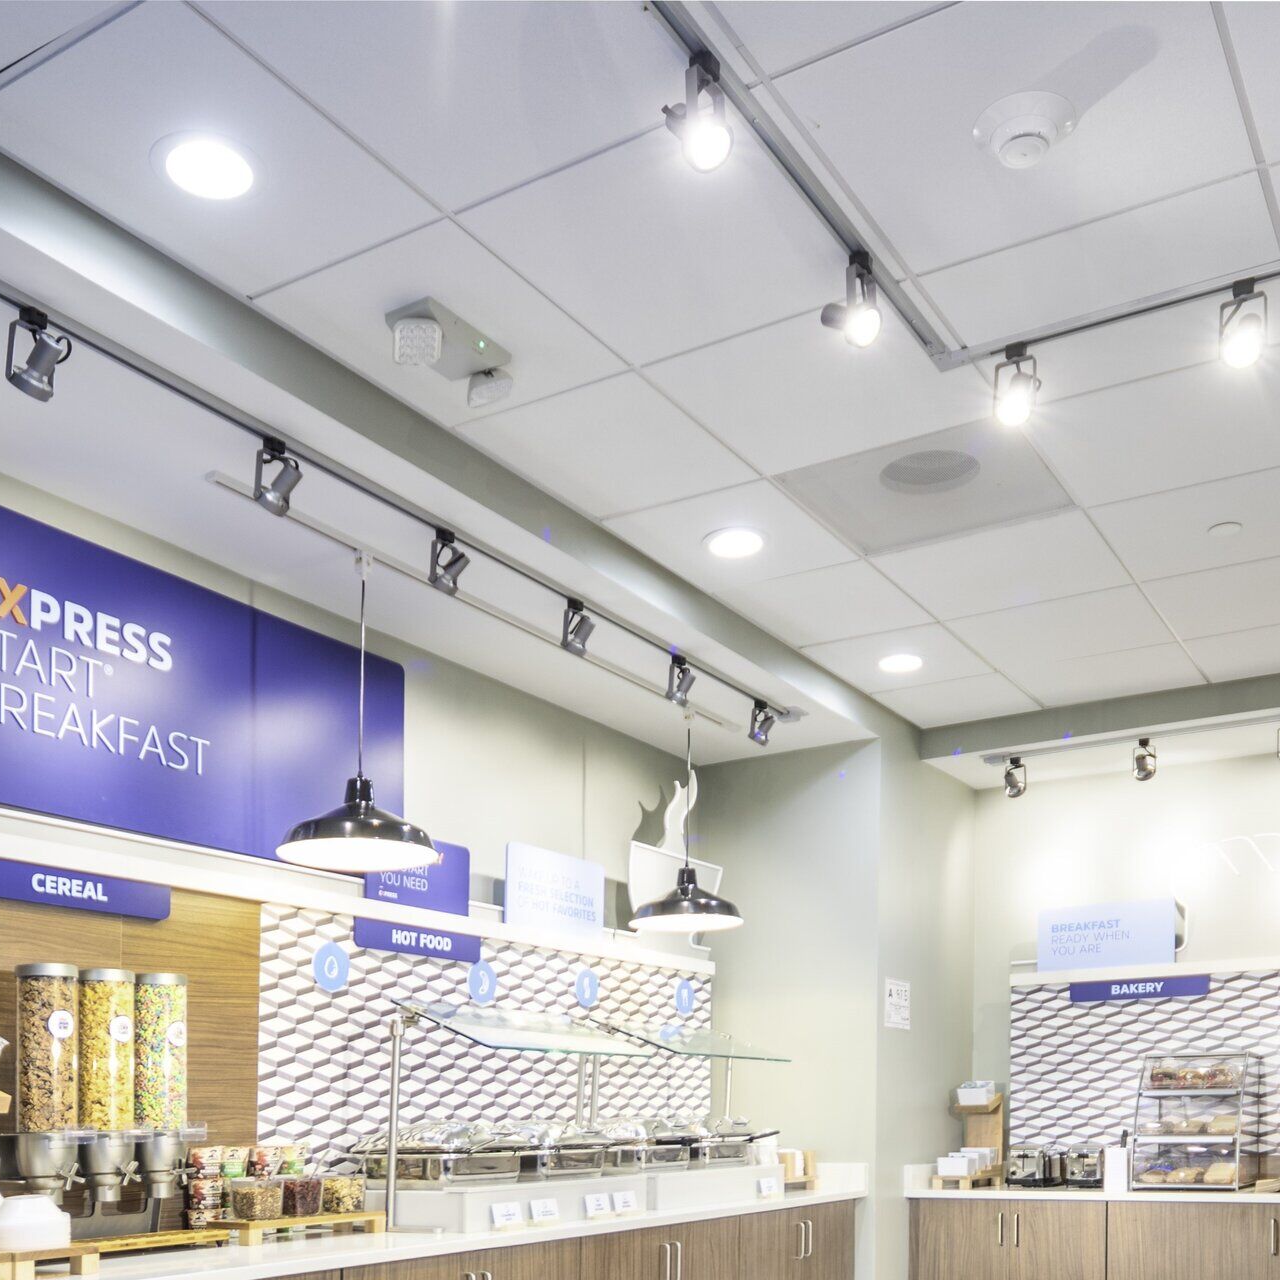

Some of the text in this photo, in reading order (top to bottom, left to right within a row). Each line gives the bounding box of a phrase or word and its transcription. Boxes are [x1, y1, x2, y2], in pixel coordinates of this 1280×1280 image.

[31, 872, 108, 902] CEREAL
[380, 872, 429, 891] YOU NEED
[1051, 918, 1120, 934] BREAKFAST
[391, 929, 452, 952] HOT FOOD
[1051, 930, 1131, 945] READY WHEN
[1051, 943, 1102, 957] YOU ARE
[1111, 981, 1164, 996] BAKERY
